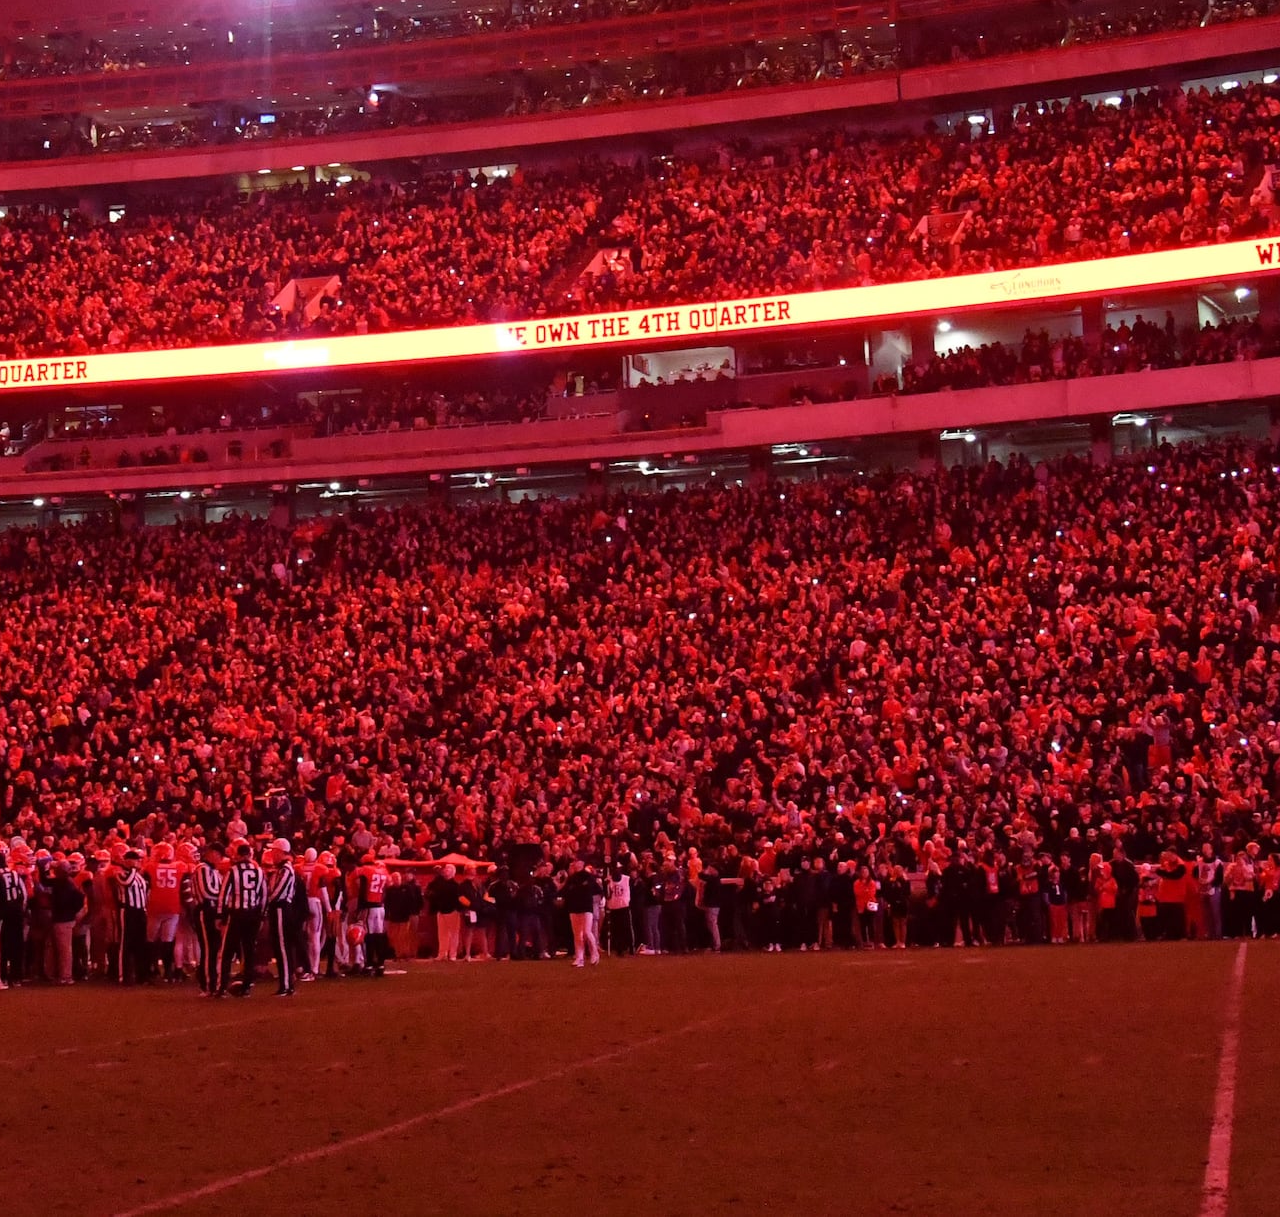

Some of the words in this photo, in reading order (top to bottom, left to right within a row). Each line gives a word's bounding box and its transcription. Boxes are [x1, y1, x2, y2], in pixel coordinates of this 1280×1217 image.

[535, 321, 580, 343] OWN
[587, 316, 629, 338] THE
[638, 311, 680, 333] 4TH
[689, 300, 791, 330] QUARTER
[156, 869, 177, 888] 55
[242, 869, 256, 889] C
[370, 873, 387, 893] 27
